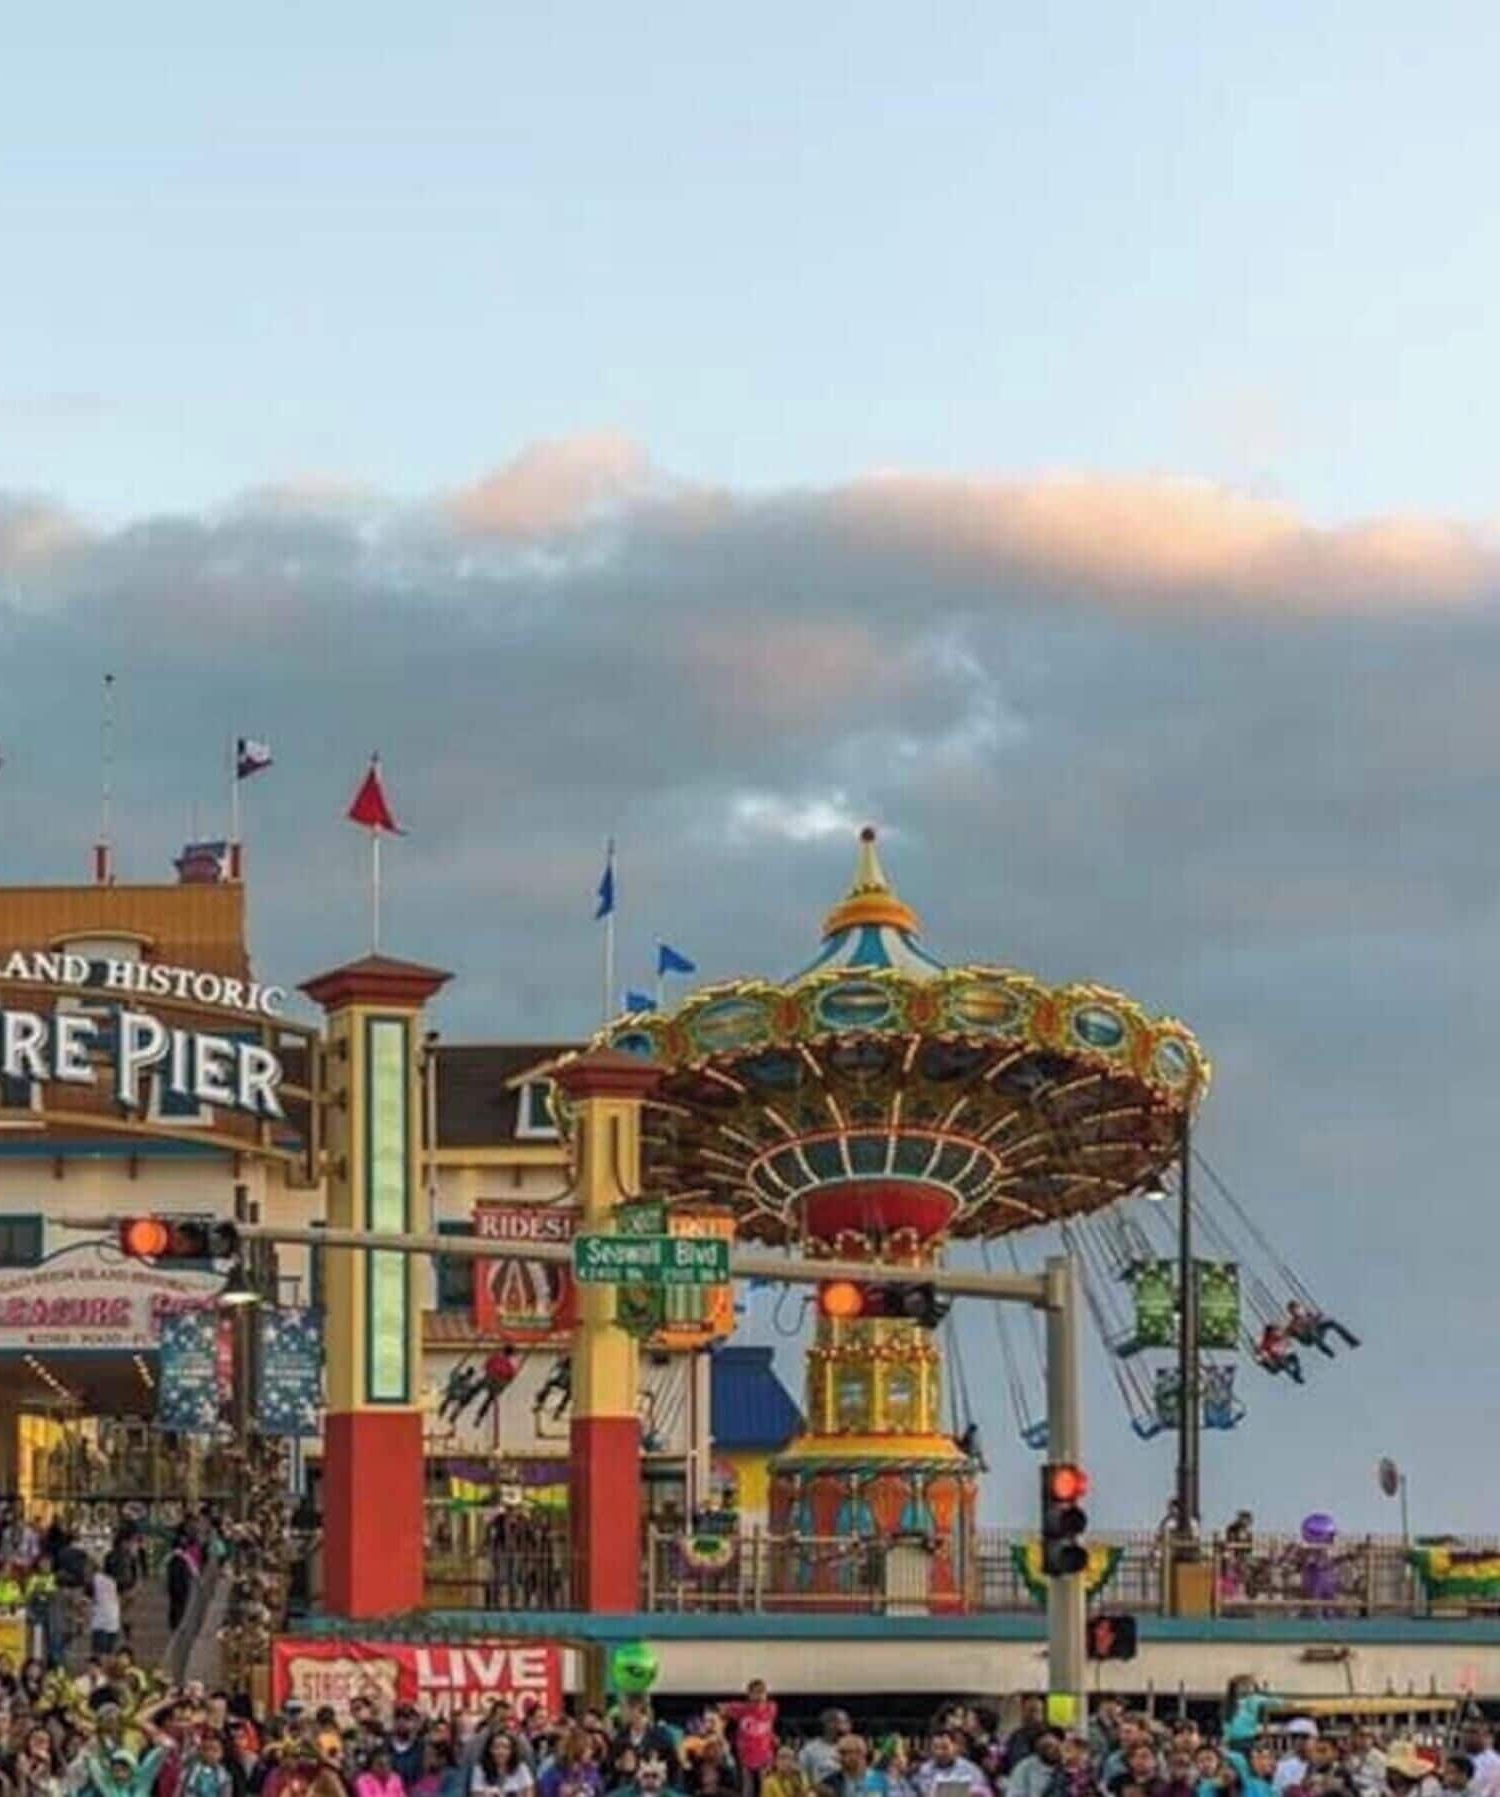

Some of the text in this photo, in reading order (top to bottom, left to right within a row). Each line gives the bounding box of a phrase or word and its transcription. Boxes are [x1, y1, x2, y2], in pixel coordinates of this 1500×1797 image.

[104, 958, 287, 1017] HISTORIC
[117, 1010, 285, 1118] PIER
[478, 1213, 571, 1239] RIDES!
[674, 1240, 719, 1266] Blvd
[414, 1648, 549, 1688] LIVE
